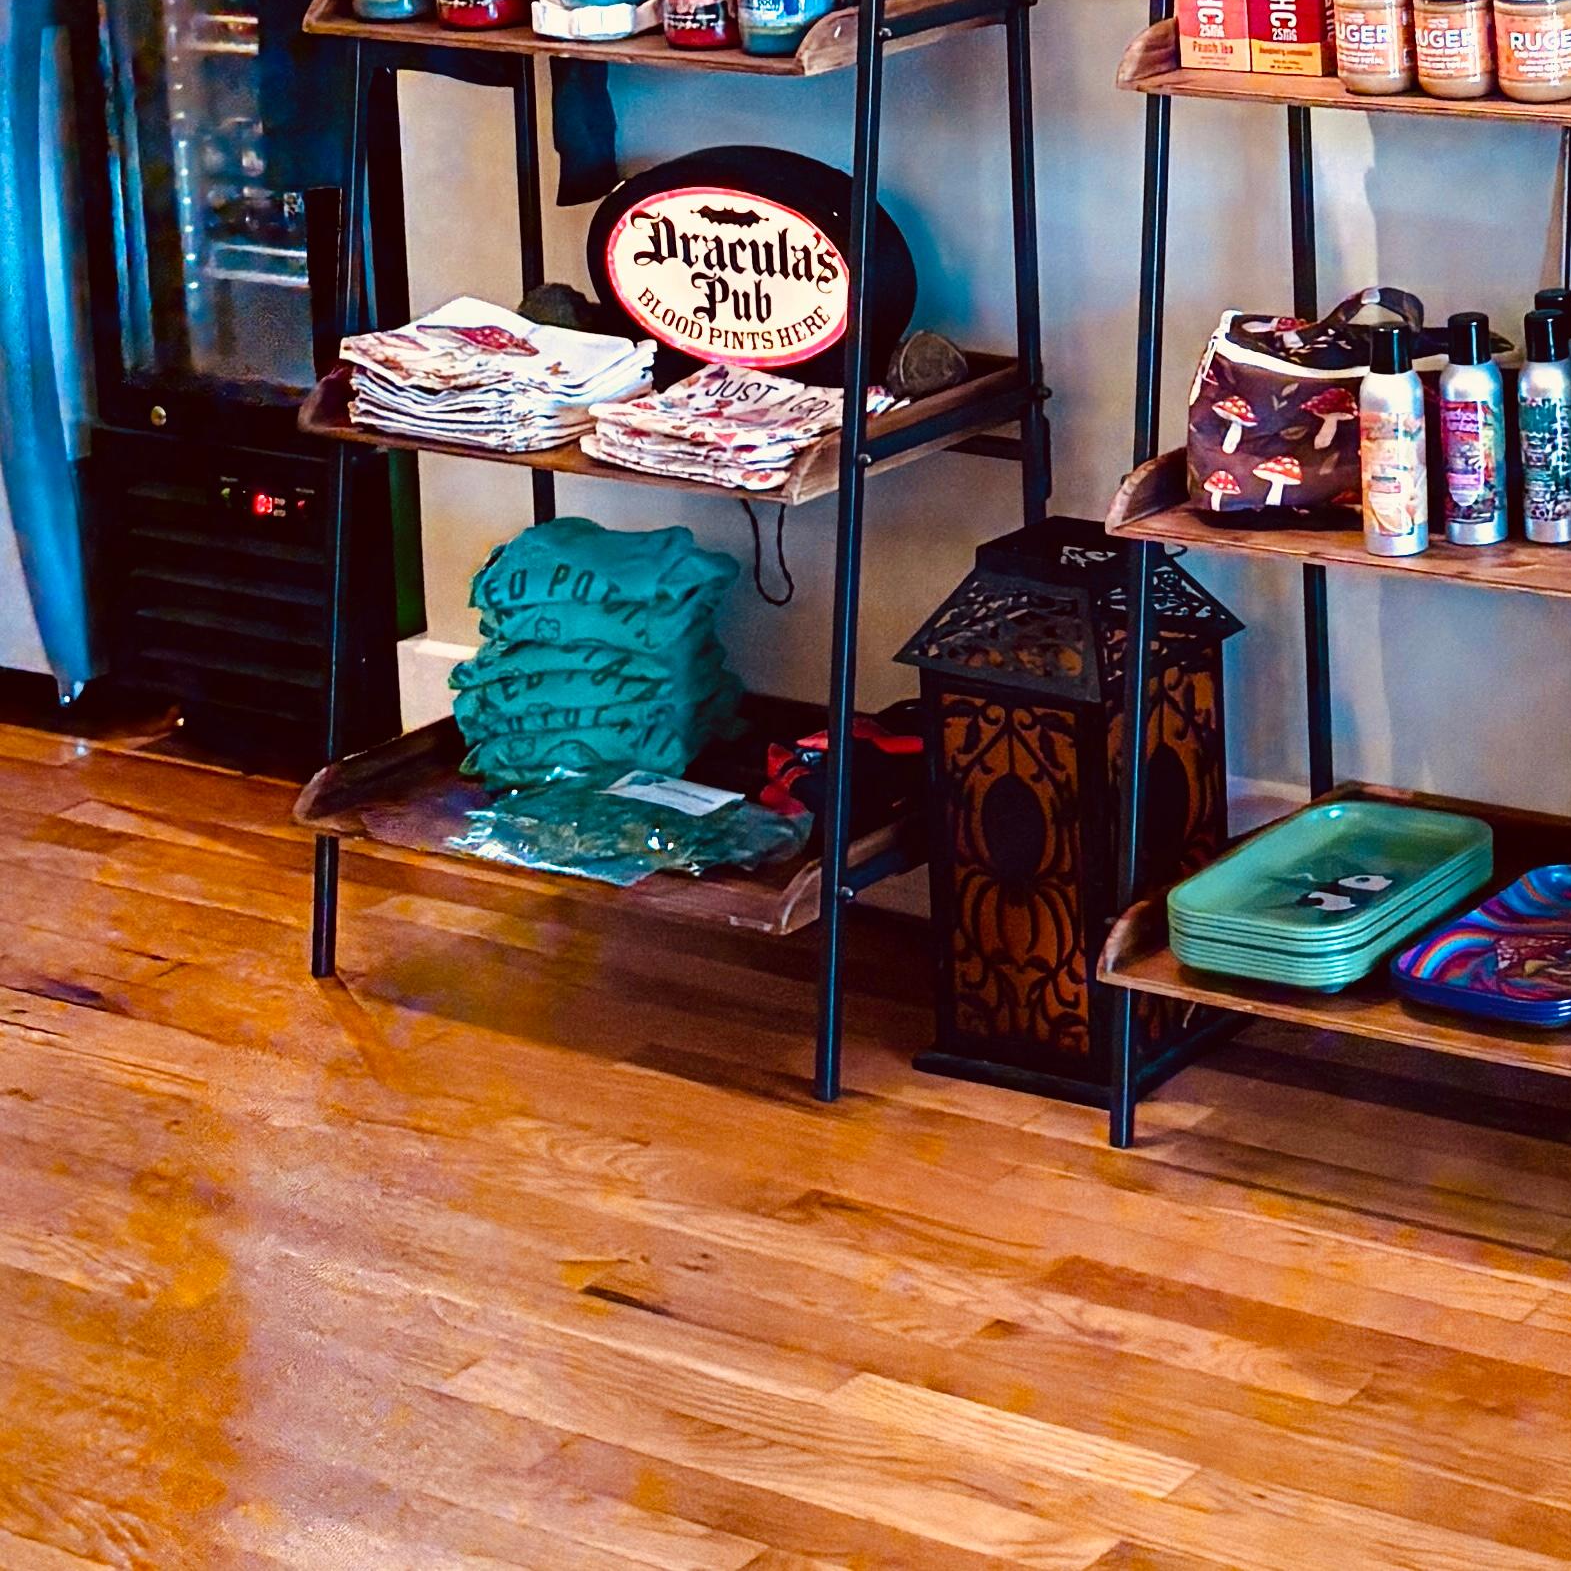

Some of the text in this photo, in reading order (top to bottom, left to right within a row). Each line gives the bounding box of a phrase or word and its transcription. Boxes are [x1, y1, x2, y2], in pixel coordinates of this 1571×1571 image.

[1336, 24, 1392, 43] UGER
[630, 209, 839, 293] Dracula's
[637, 287, 831, 350] BLOOD PINTS HERE
[691, 271, 772, 324] Pub
[705, 379, 780, 404] JUST
